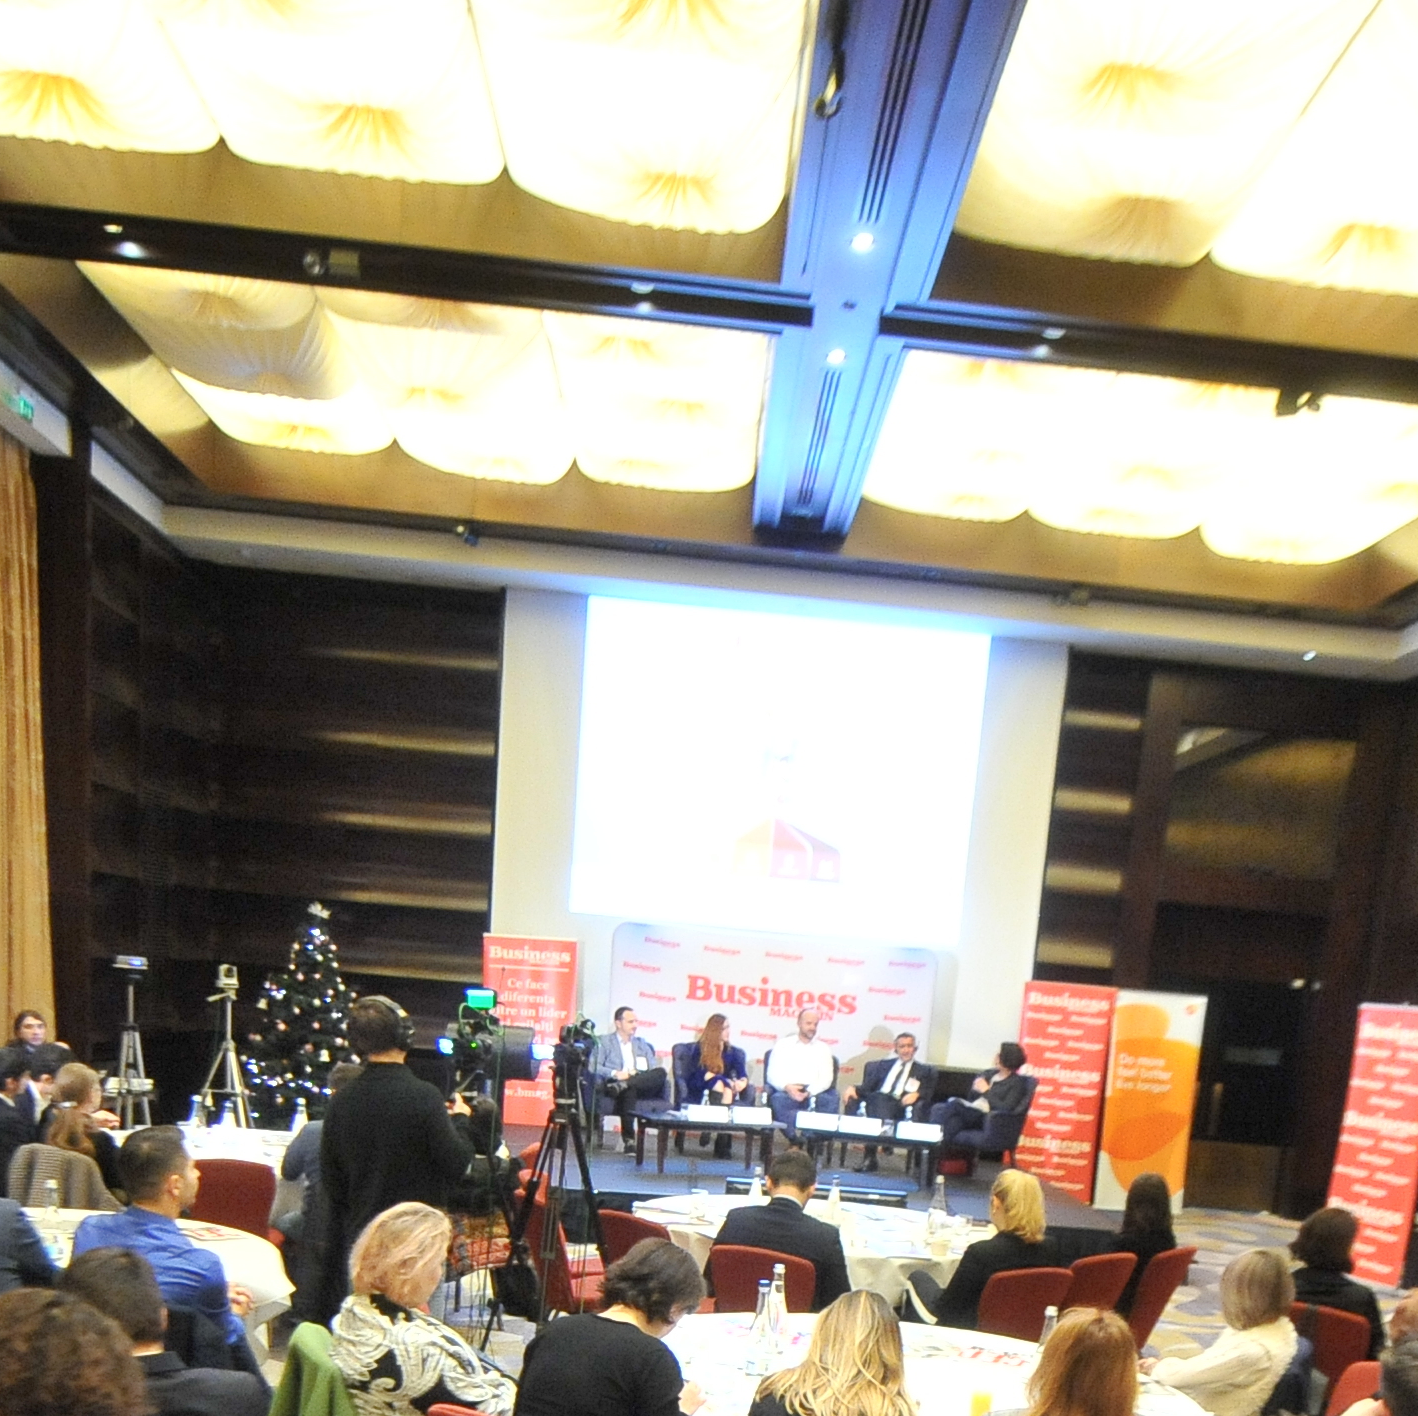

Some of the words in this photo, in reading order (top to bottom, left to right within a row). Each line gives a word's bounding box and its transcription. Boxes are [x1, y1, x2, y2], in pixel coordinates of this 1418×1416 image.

[489, 945, 572, 964] Business
[686, 974, 858, 1015] Business
[769, 1006, 835, 1021] MAGIN
